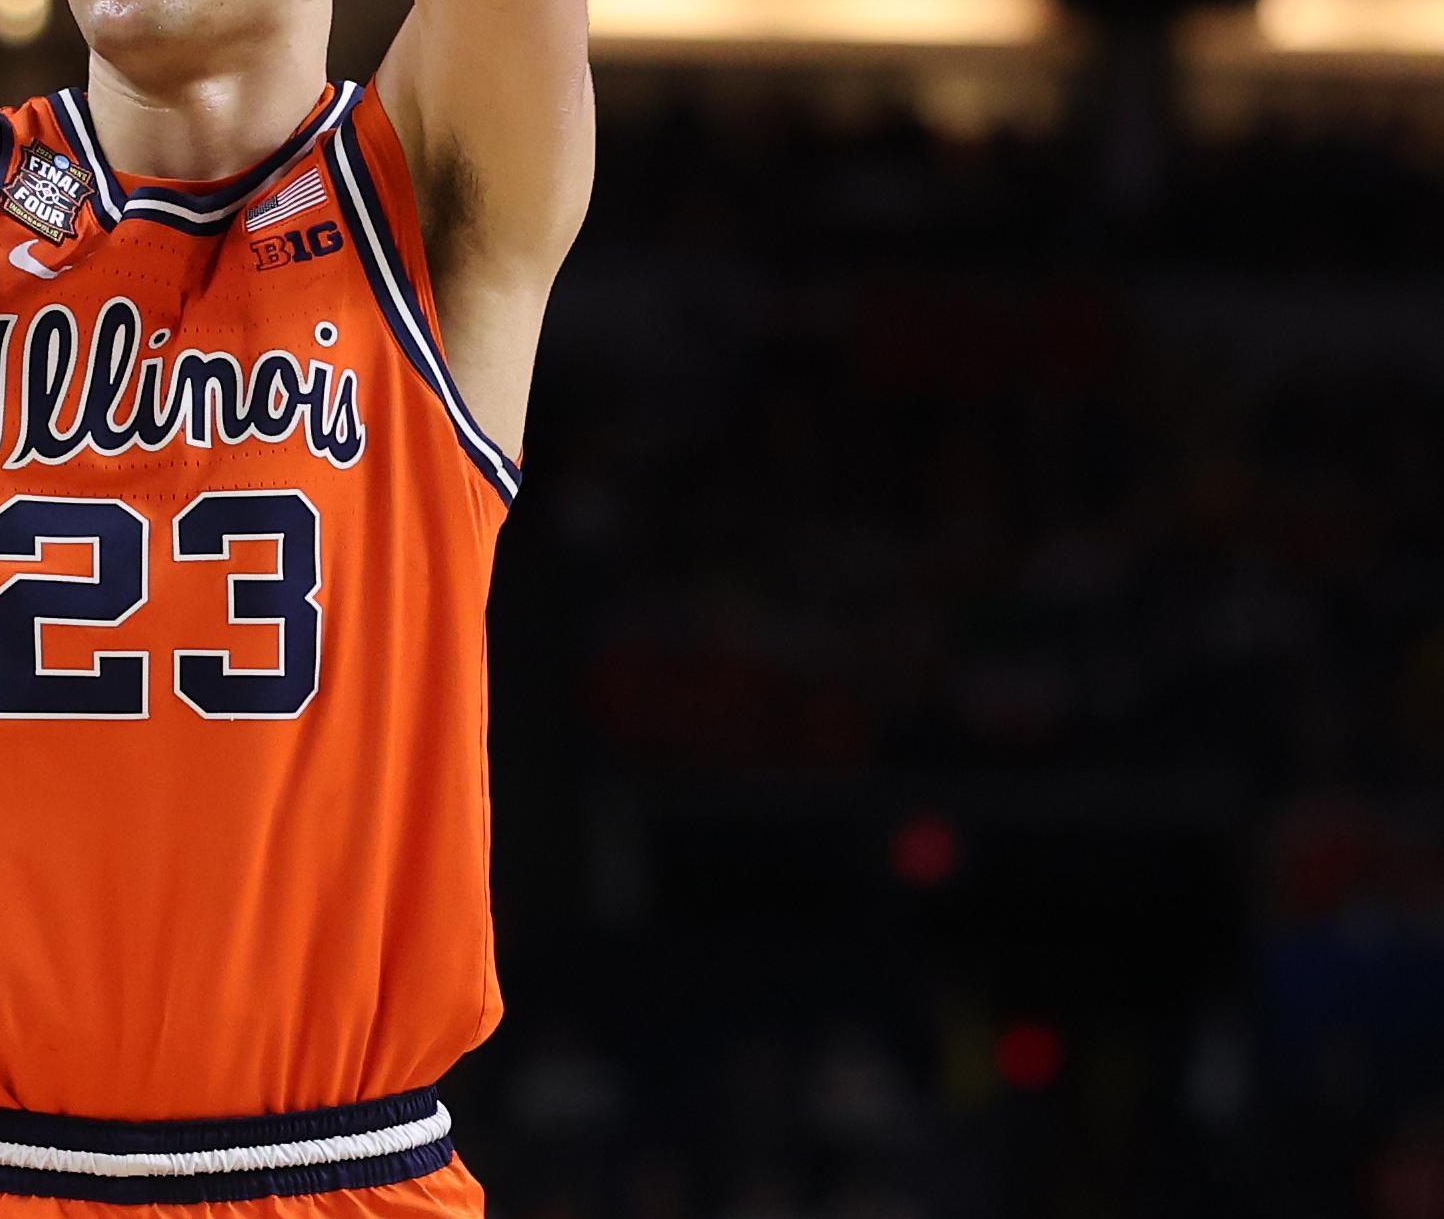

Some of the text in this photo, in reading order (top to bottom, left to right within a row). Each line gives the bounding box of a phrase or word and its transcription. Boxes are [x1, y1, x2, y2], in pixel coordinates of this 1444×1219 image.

[29, 155, 80, 198] FINAL
[8, 202, 59, 237] INDIANAPOLIS
[13, 186, 65, 228] FOUR
